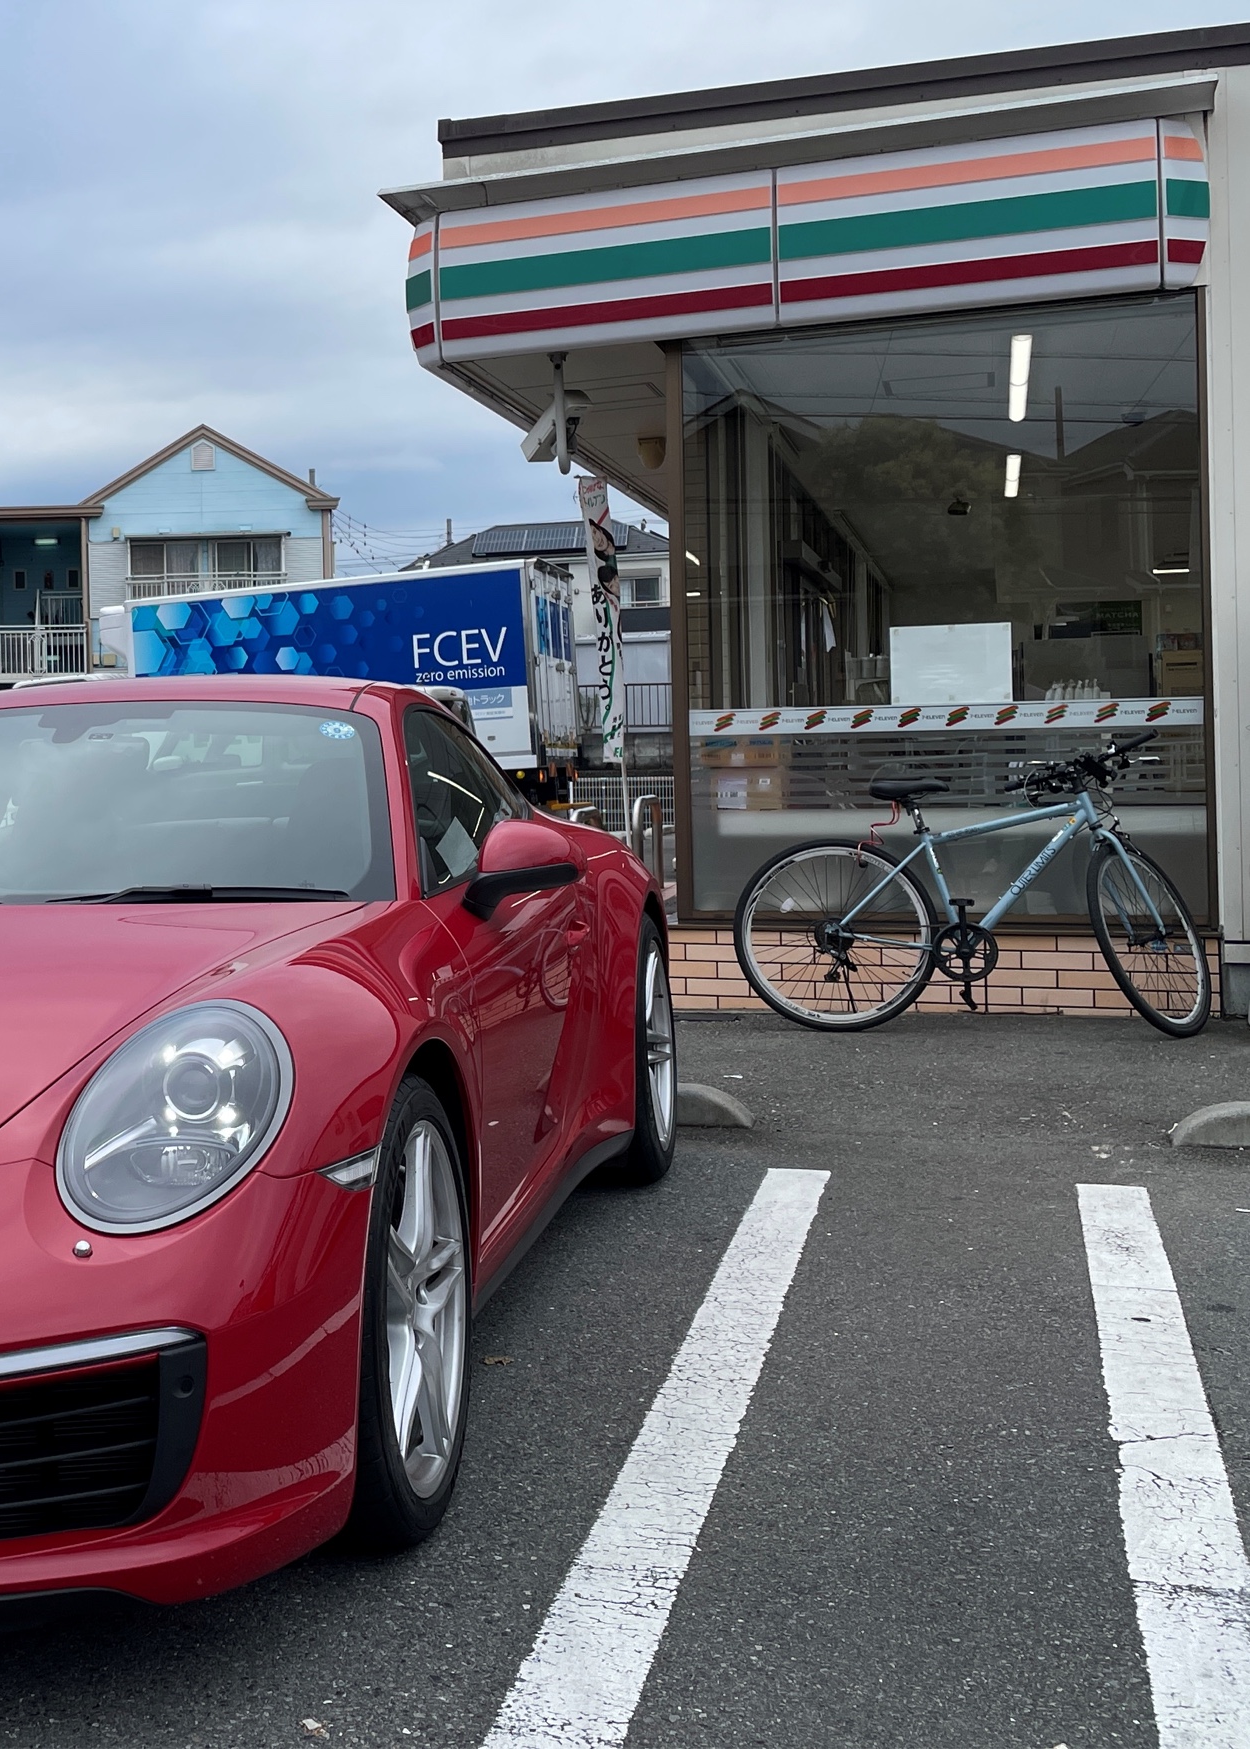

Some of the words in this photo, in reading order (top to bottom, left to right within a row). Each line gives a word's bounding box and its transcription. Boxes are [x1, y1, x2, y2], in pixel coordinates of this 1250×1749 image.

[412, 626, 507, 669] FCEV
[415, 671, 444, 683] zero
[447, 664, 506, 681] emission
[1010, 869, 1036, 896] OUTER
[1030, 846, 1056, 873] LIMITS
